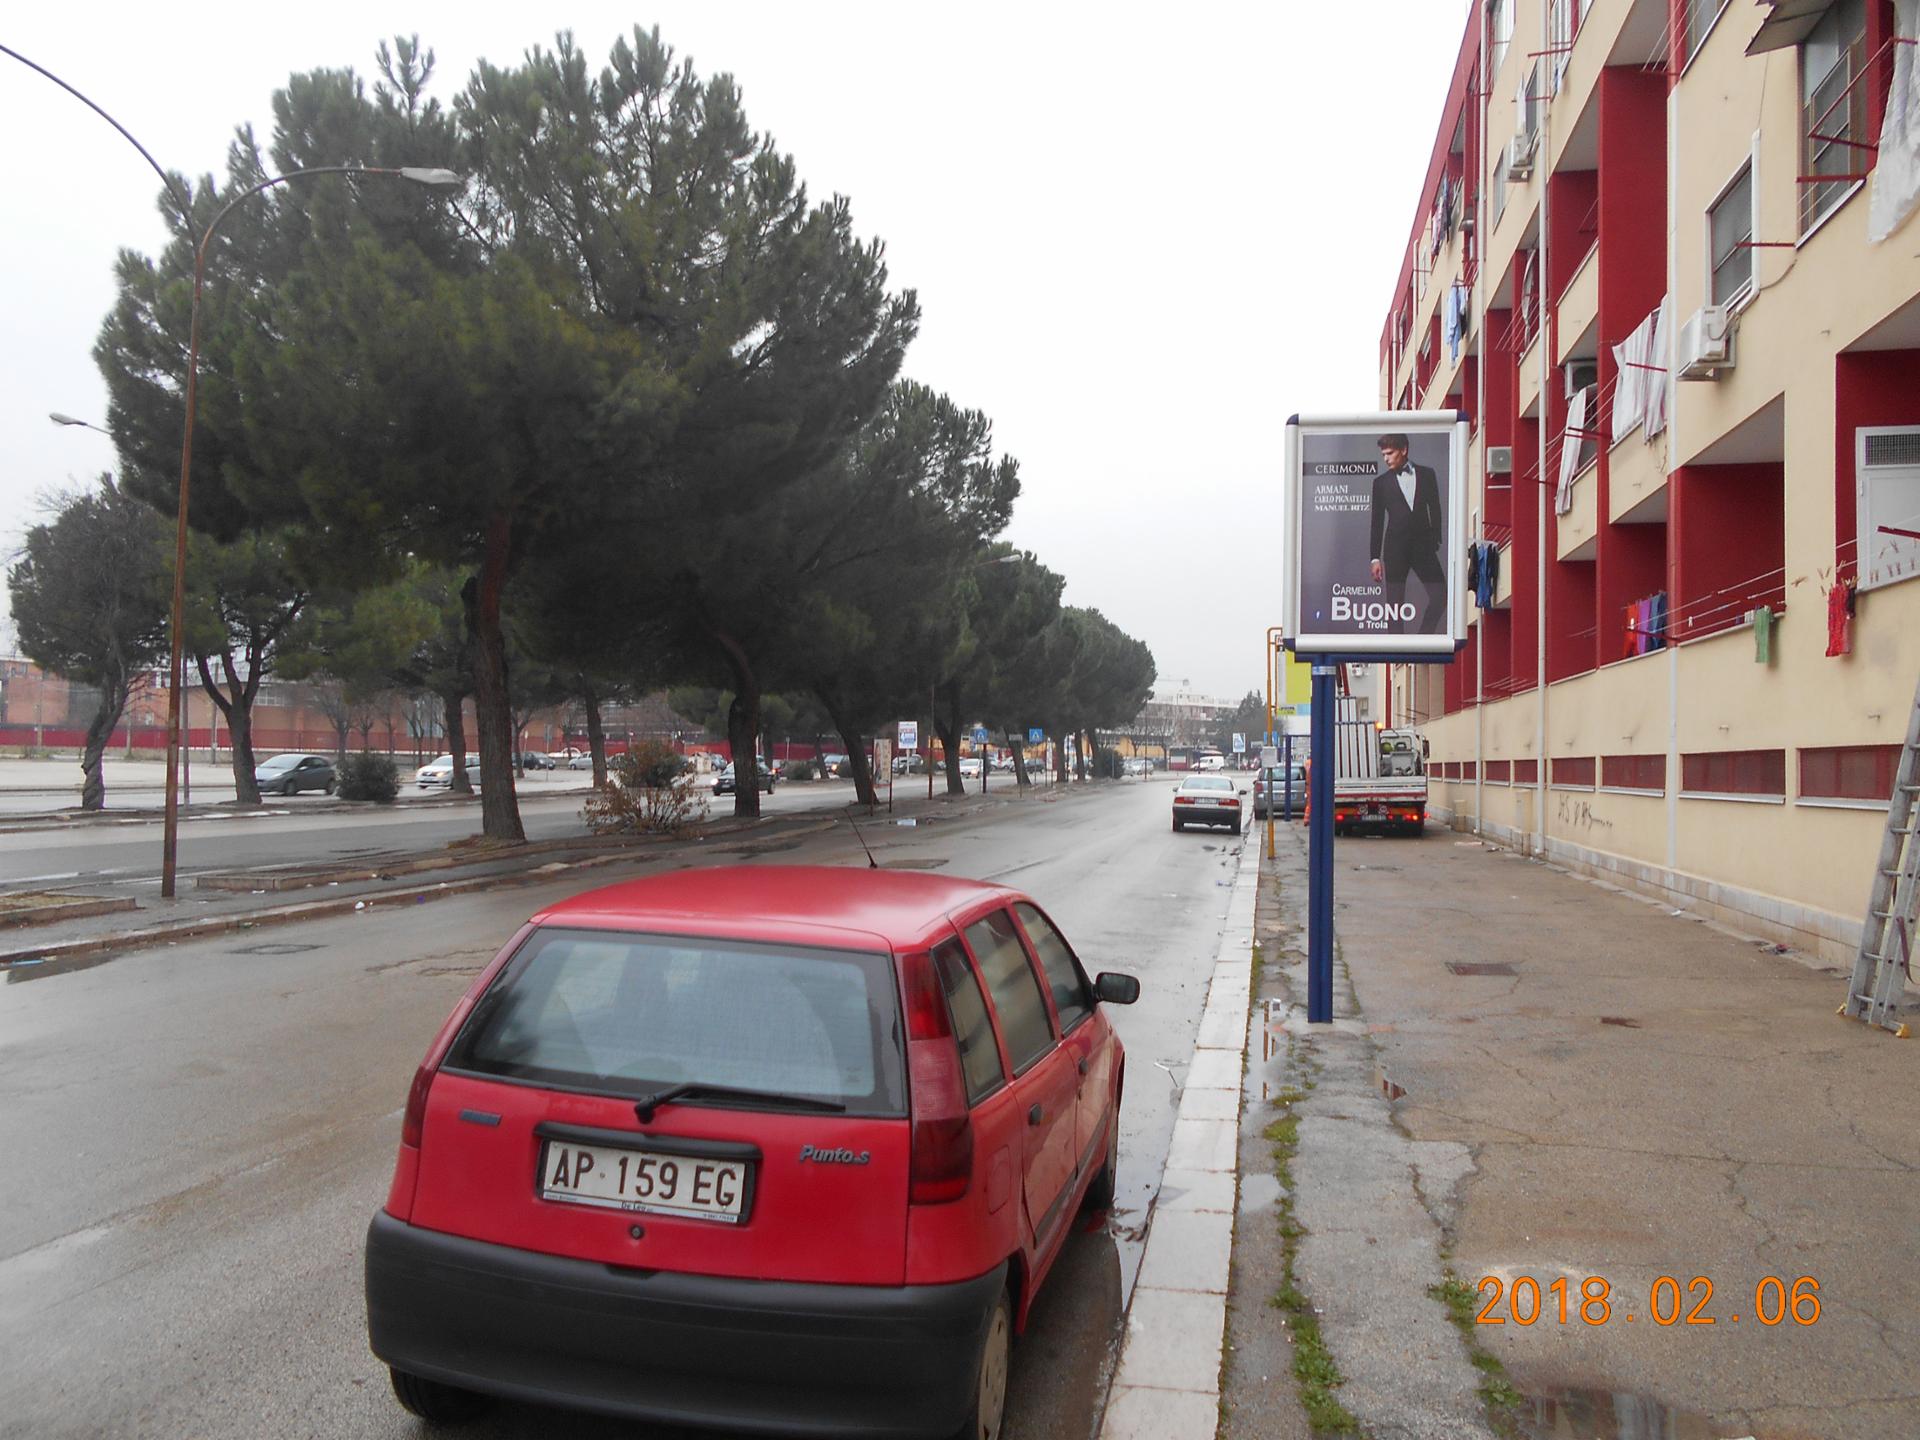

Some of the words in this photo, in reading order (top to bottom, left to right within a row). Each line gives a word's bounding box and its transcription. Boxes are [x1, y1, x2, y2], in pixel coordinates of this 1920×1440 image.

[1315, 464, 1377, 474] CERIMONIA
[1315, 485, 1348, 494] ARMANI
[1314, 496, 1335, 504] CARLO
[1335, 495, 1370, 503] PIGNATELLI
[1332, 583, 1382, 596] CARMELINO
[1331, 596, 1416, 621] BUONO
[799, 1144, 854, 1163] Punto
[552, 1148, 595, 1189] AP
[618, 1156, 680, 1200] 159
[691, 1165, 737, 1207] EG
